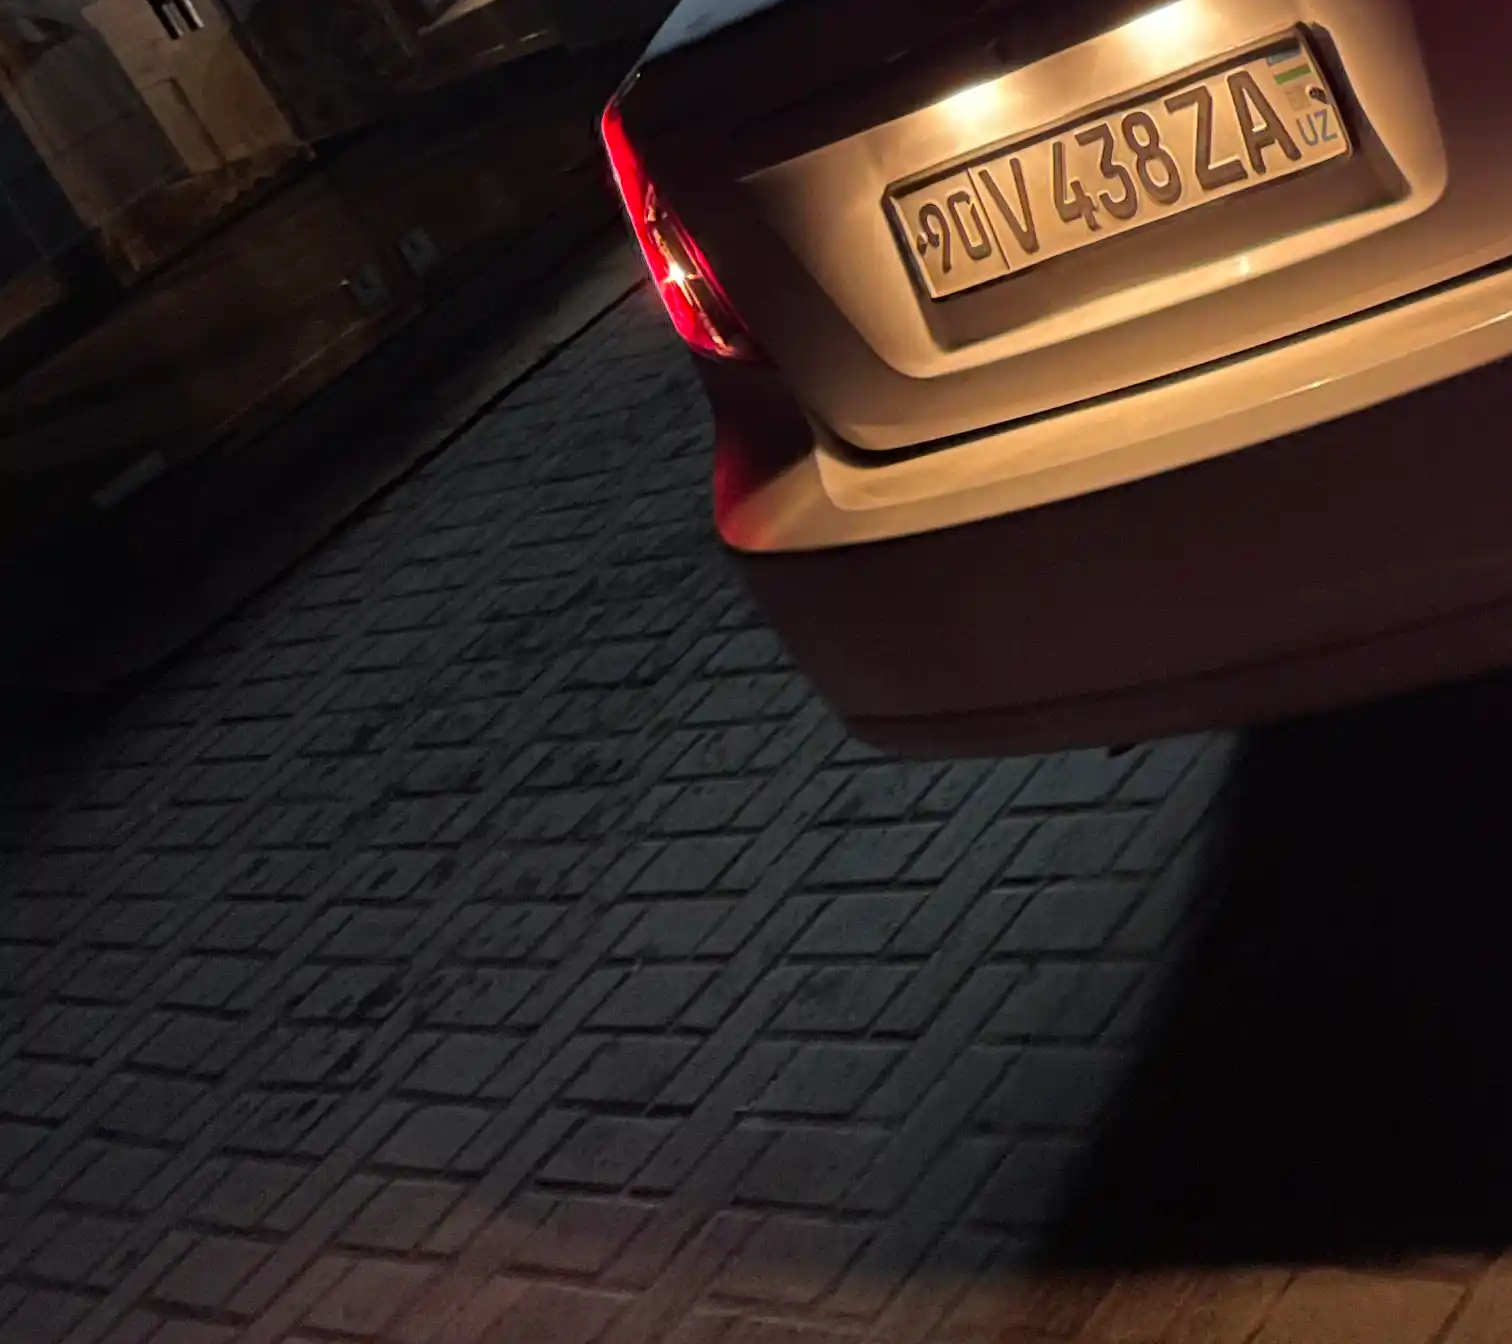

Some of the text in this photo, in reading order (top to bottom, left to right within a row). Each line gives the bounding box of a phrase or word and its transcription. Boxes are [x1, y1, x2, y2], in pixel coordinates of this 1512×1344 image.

[978, 157, 1040, 254] V
[1052, 110, 1182, 231] 438
[1163, 69, 1303, 191] ZA
[1294, 107, 1339, 147] UZ
